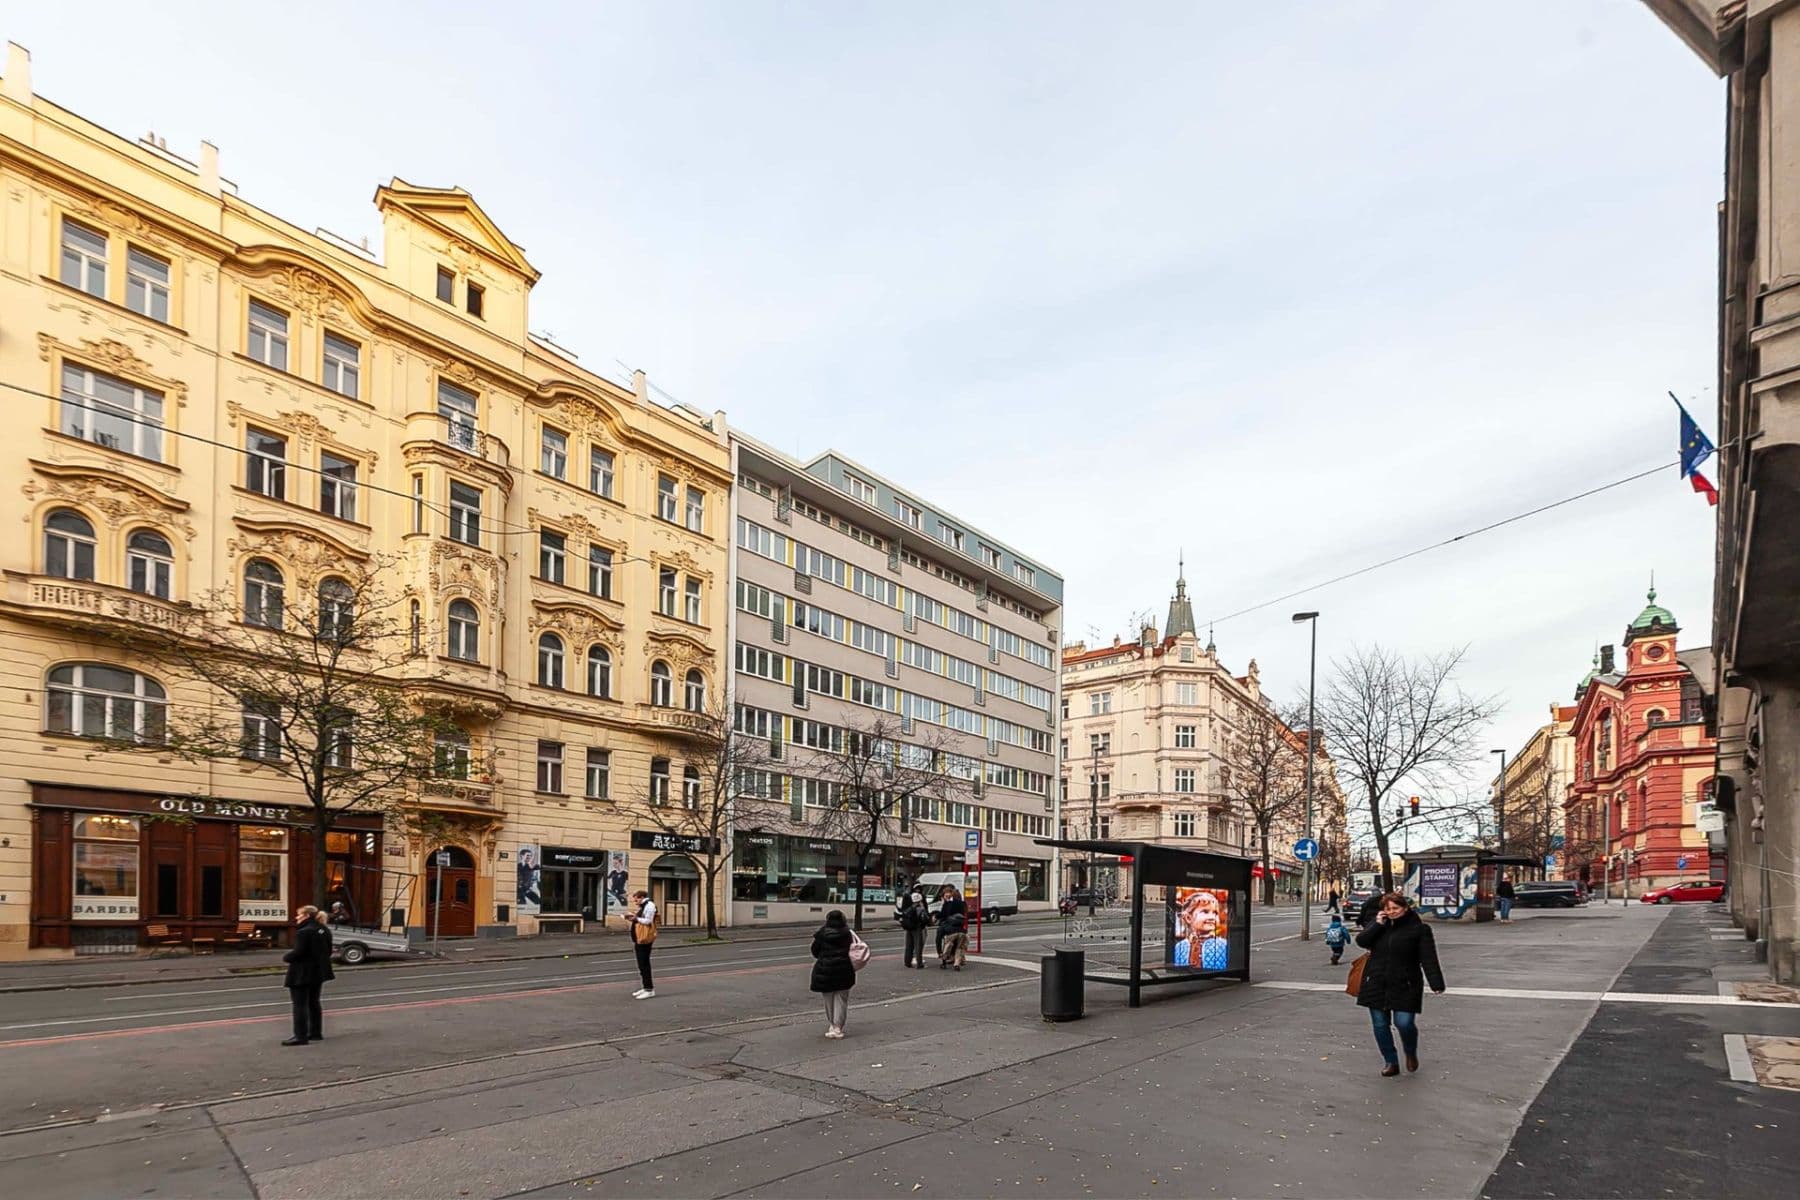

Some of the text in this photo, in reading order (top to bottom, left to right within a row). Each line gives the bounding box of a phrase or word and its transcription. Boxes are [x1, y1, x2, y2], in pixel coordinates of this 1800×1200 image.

[160, 799, 289, 820] OLD MONEY
[74, 905, 138, 914] BARBER
